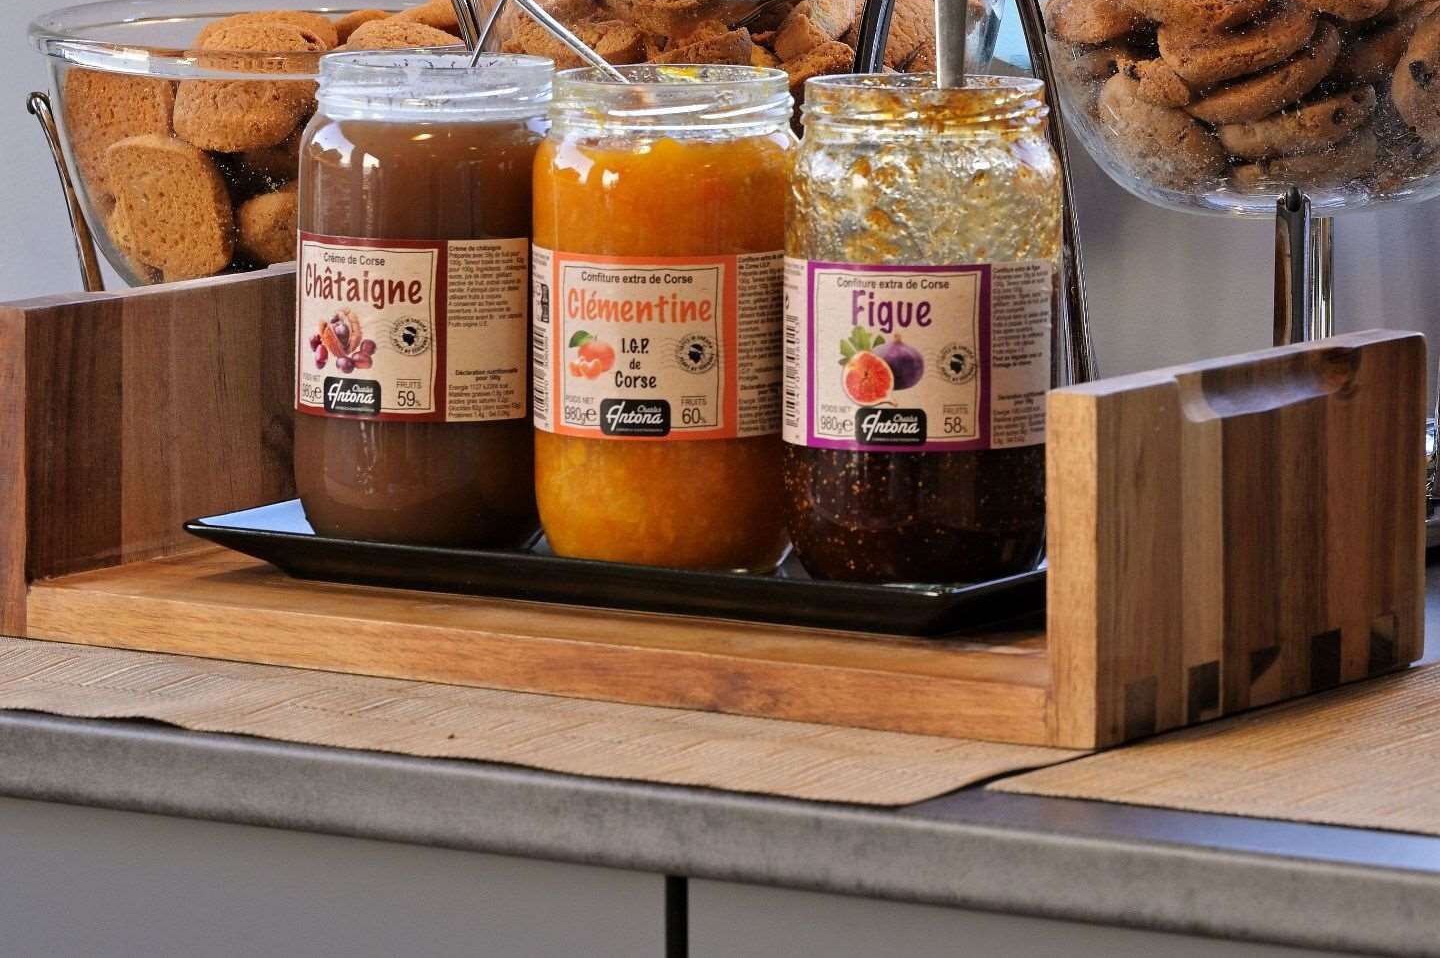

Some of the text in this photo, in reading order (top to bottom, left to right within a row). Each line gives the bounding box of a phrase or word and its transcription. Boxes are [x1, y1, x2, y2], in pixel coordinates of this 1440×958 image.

[324, 252, 385, 267] Crème de Corse
[305, 263, 423, 310] Châtaigne
[581, 271, 693, 285] Confiture extra de Corse
[837, 277, 949, 291] Confiture extra de Corse
[567, 288, 713, 324] Clémentine
[851, 290, 932, 333] Figue
[629, 358, 641, 371] de
[328, 379, 375, 409] Antona
[615, 372, 657, 389] Corse
[606, 401, 663, 431] Antona
[862, 410, 920, 441] Antona
